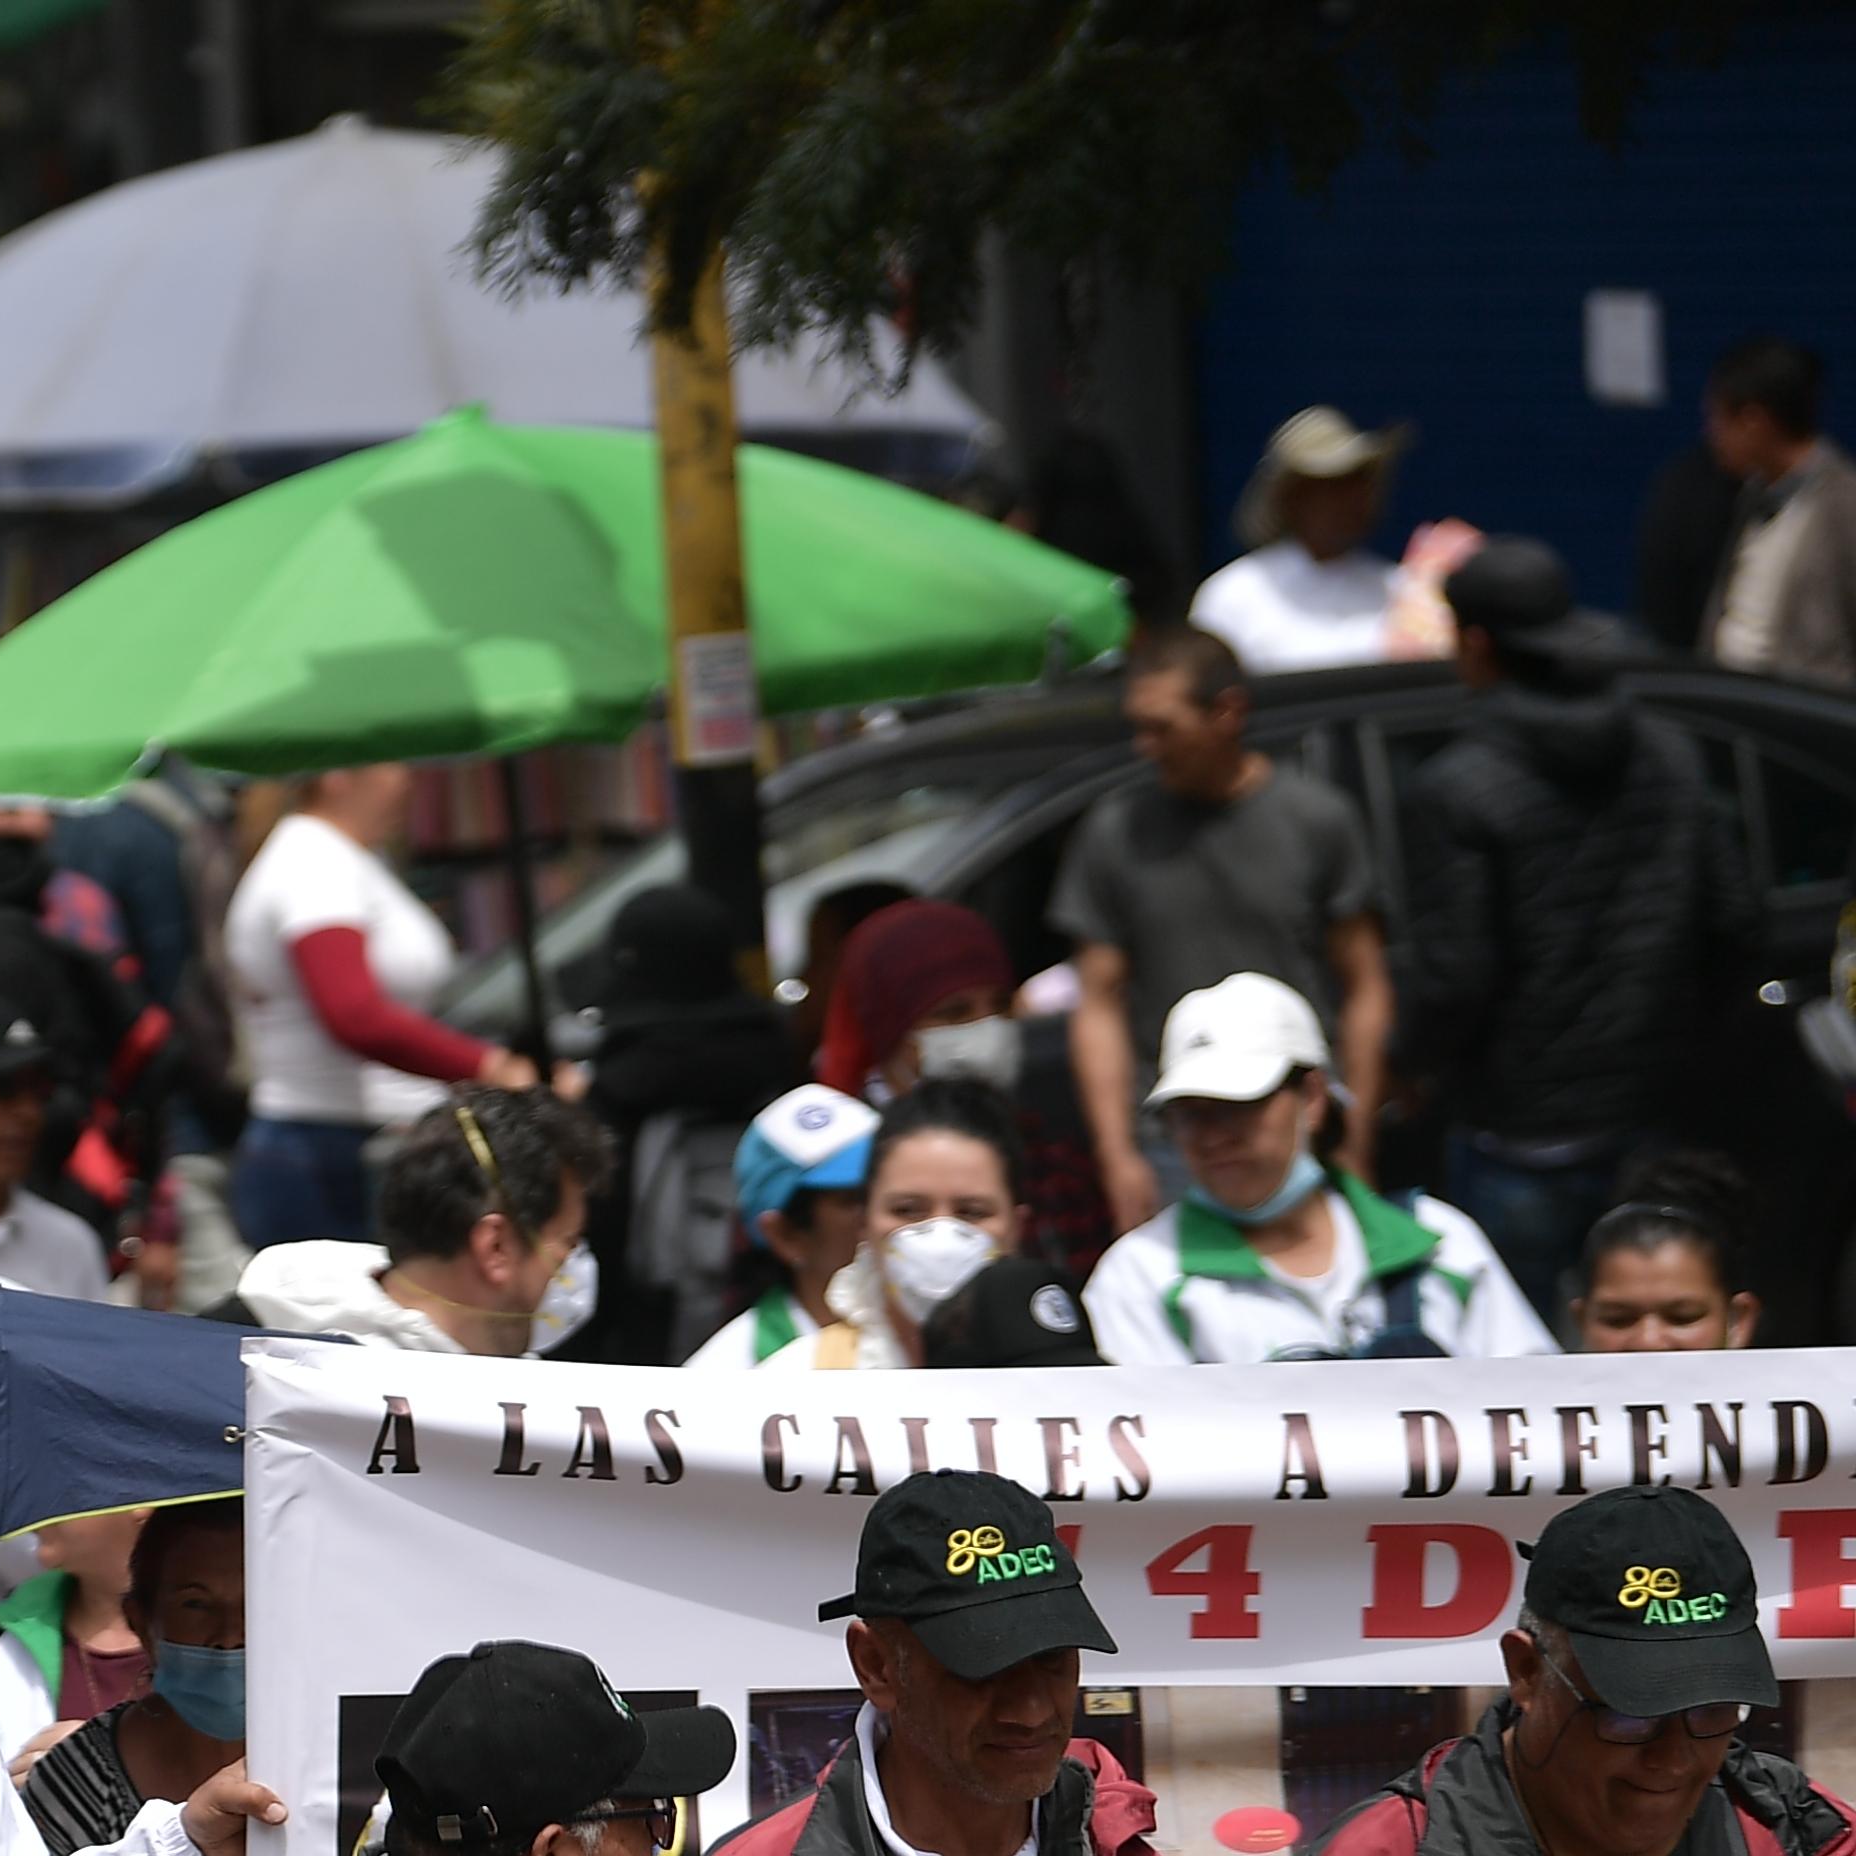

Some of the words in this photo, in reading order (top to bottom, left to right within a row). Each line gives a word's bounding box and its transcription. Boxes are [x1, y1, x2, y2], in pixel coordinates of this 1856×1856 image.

[367, 1395, 421, 1474] A
[493, 1402, 685, 1485] LAS
[760, 1413, 1153, 1501] CALLES
[1273, 1412, 1329, 1500] A
[1397, 1400, 1856, 1498] DEFEND
[977, 1543, 1056, 1584] ADEC
[1643, 1592, 1728, 1625] ADEC
